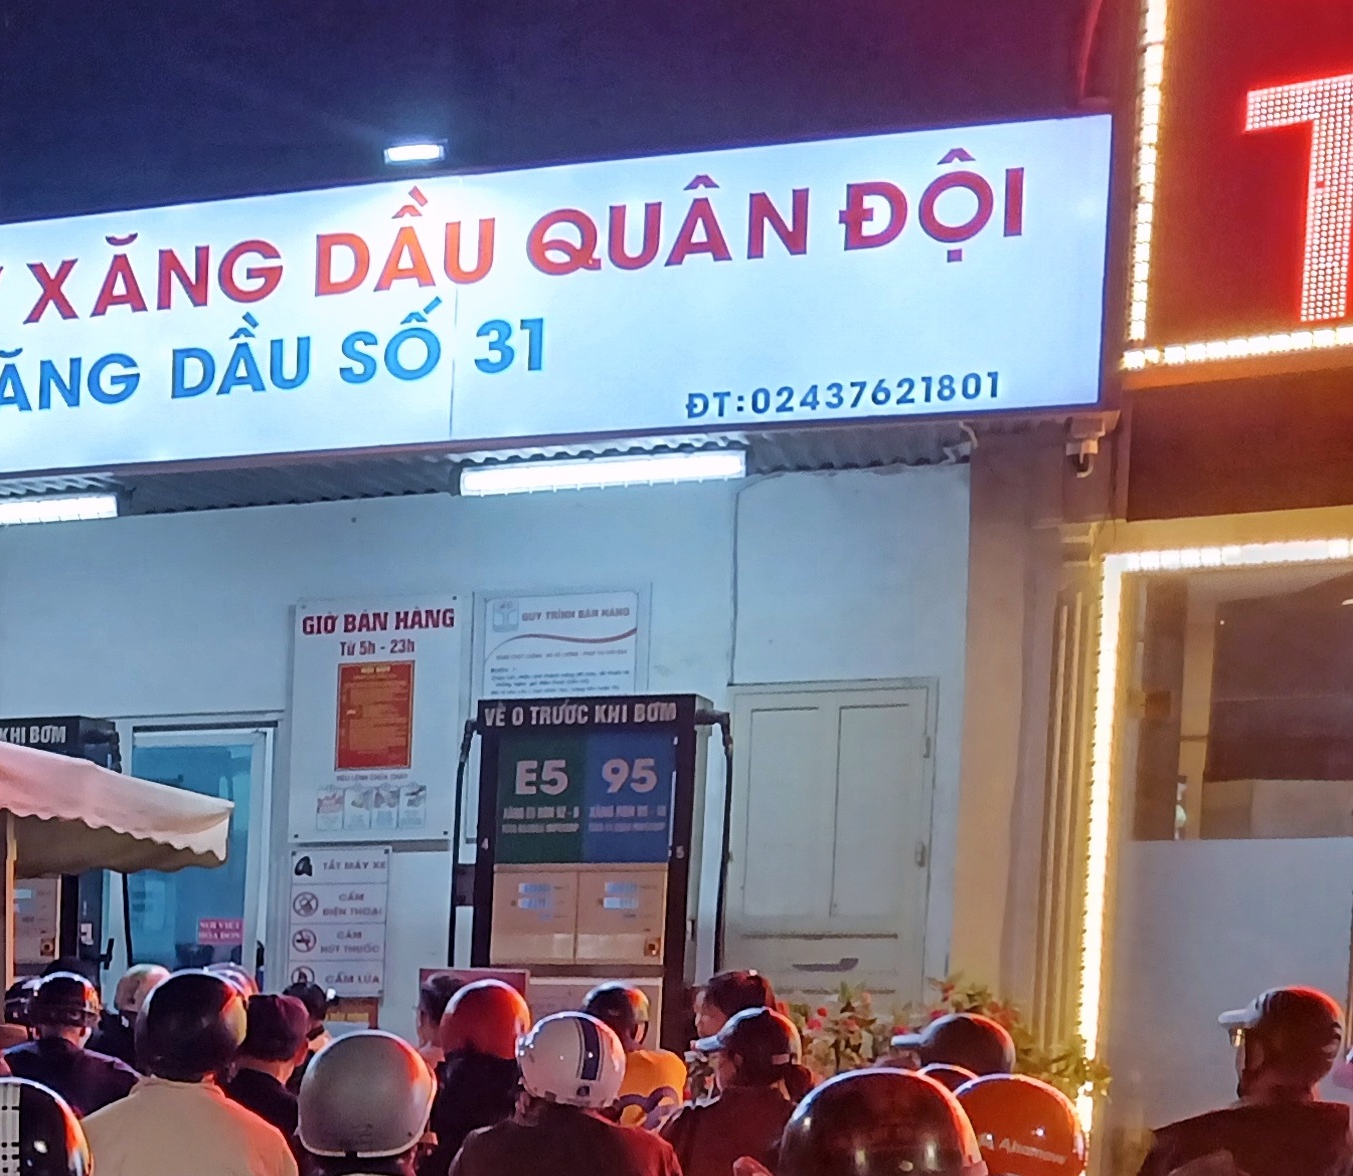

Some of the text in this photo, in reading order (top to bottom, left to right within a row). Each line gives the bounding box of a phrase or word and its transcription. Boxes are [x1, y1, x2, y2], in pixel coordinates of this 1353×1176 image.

[23, 232, 283, 324] XĂNG
[315, 186, 494, 297] DẦU
[526, 174, 810, 276] QUÂN
[840, 148, 1024, 264] ĐỘI
[171, 312, 311, 399] DẦU
[340, 297, 441, 383] SỐ
[474, 317, 545, 374] 31
[687, 371, 1000, 419] ĐT:02437621801
[302, 605, 454, 635] GIỜ BÁN HÀNG
[359, 640, 376, 655] 5h
[390, 638, 415, 654] 23h
[484, 702, 505, 726] VỀ
[530, 699, 589, 725] TRƯỚC
[595, 705, 627, 724] KHI
[634, 702, 677, 722] BƠM
[30, 725, 67, 744] BƠM
[514, 759, 569, 796] E5
[602, 758, 658, 794] 95
